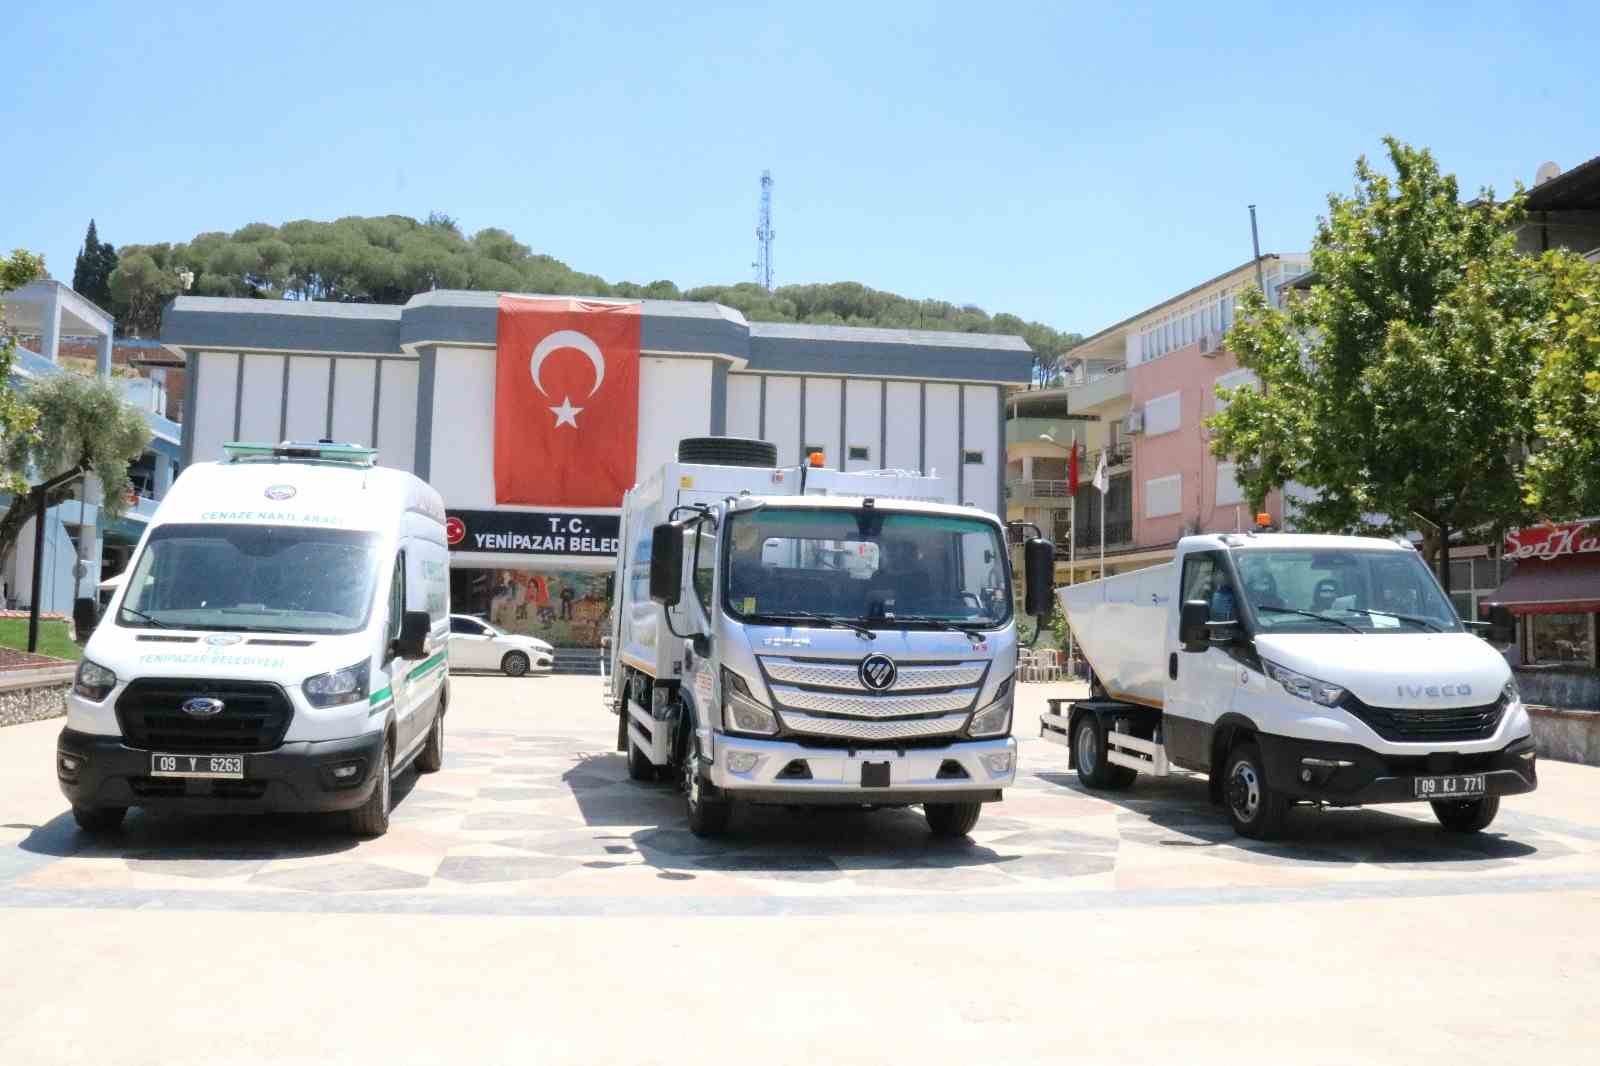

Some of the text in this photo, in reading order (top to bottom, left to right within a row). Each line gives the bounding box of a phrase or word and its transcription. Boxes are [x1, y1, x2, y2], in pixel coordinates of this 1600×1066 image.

[549, 518, 591, 533] T.C.
[475, 532, 620, 552] YENİPAZAR BELED
[1397, 683, 1472, 697] IVECO
[160, 757, 241, 772] 09 Y 6263
[1422, 780, 1436, 793] 09
[1463, 777, 1482, 791] 771
